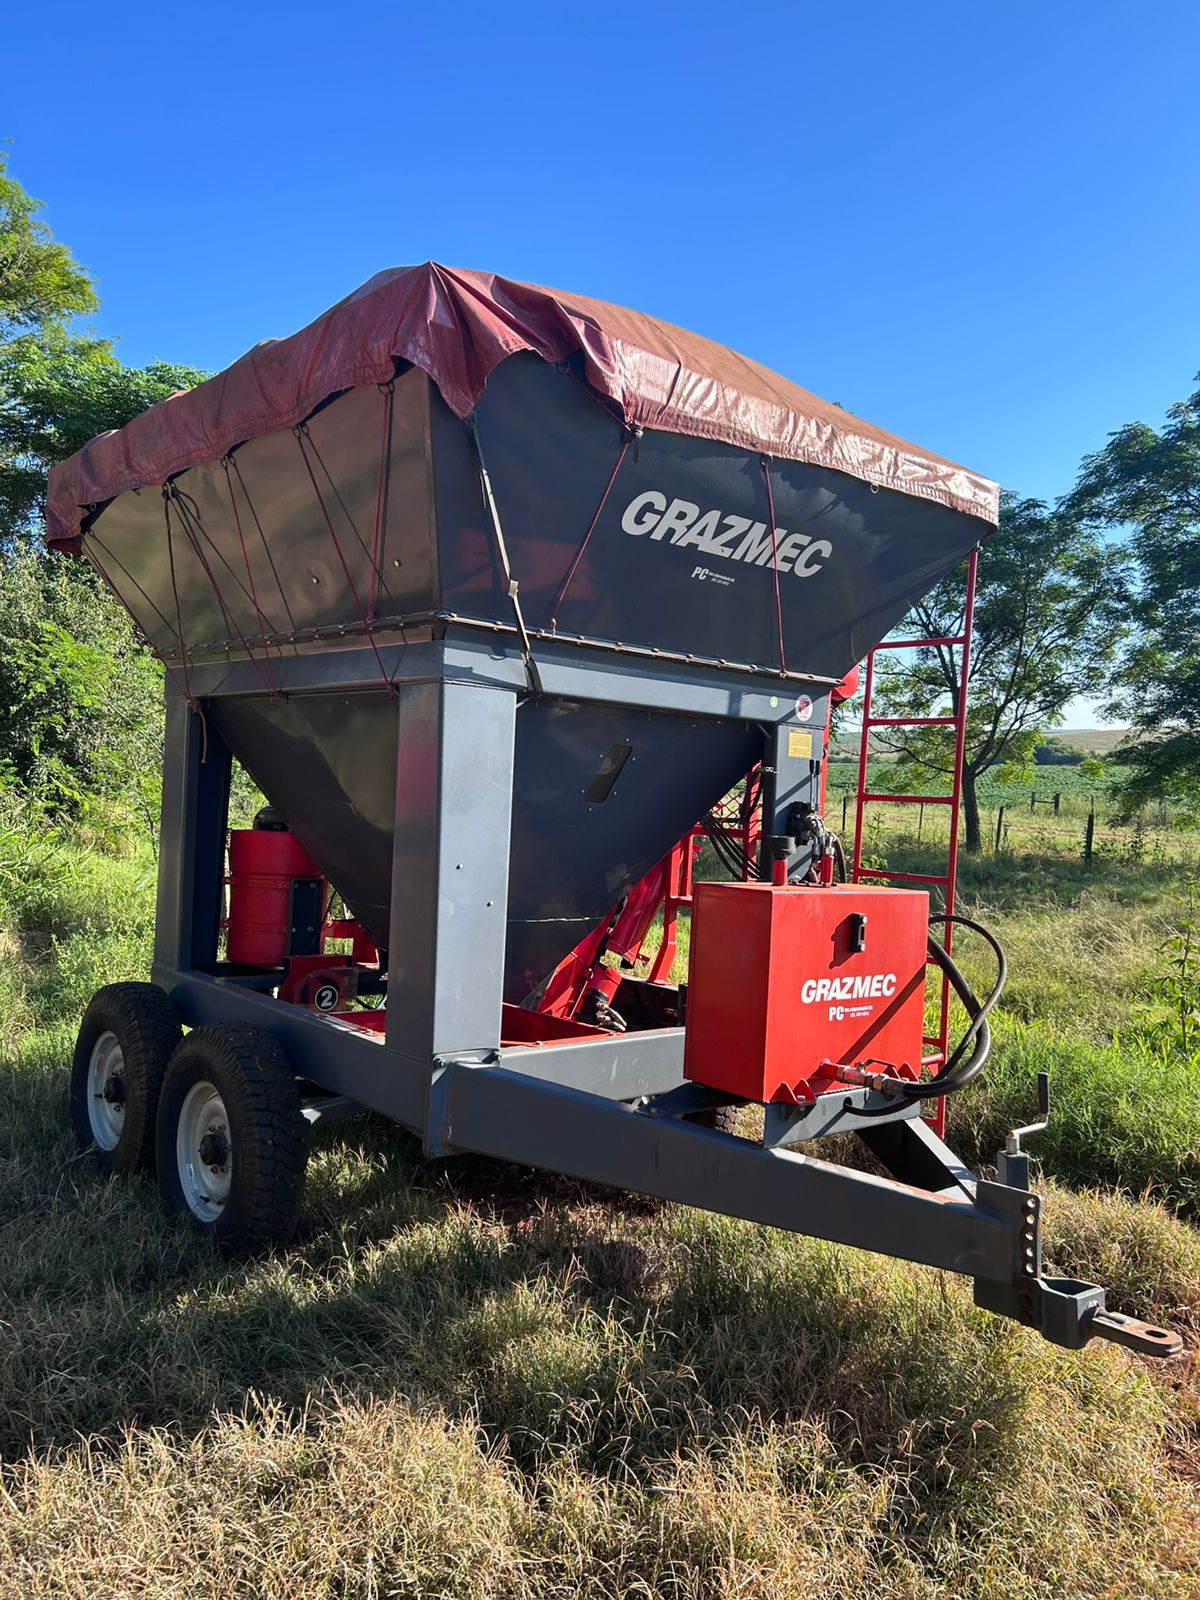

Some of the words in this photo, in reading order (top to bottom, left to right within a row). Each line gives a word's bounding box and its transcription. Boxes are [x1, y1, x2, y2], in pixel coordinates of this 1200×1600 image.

[621, 490, 833, 578] GRAZMEC
[691, 566, 709, 580] PC
[801, 973, 897, 1004] GRAZMEC
[320, 989, 333, 1008] 2
[828, 1005, 844, 1021] PC
